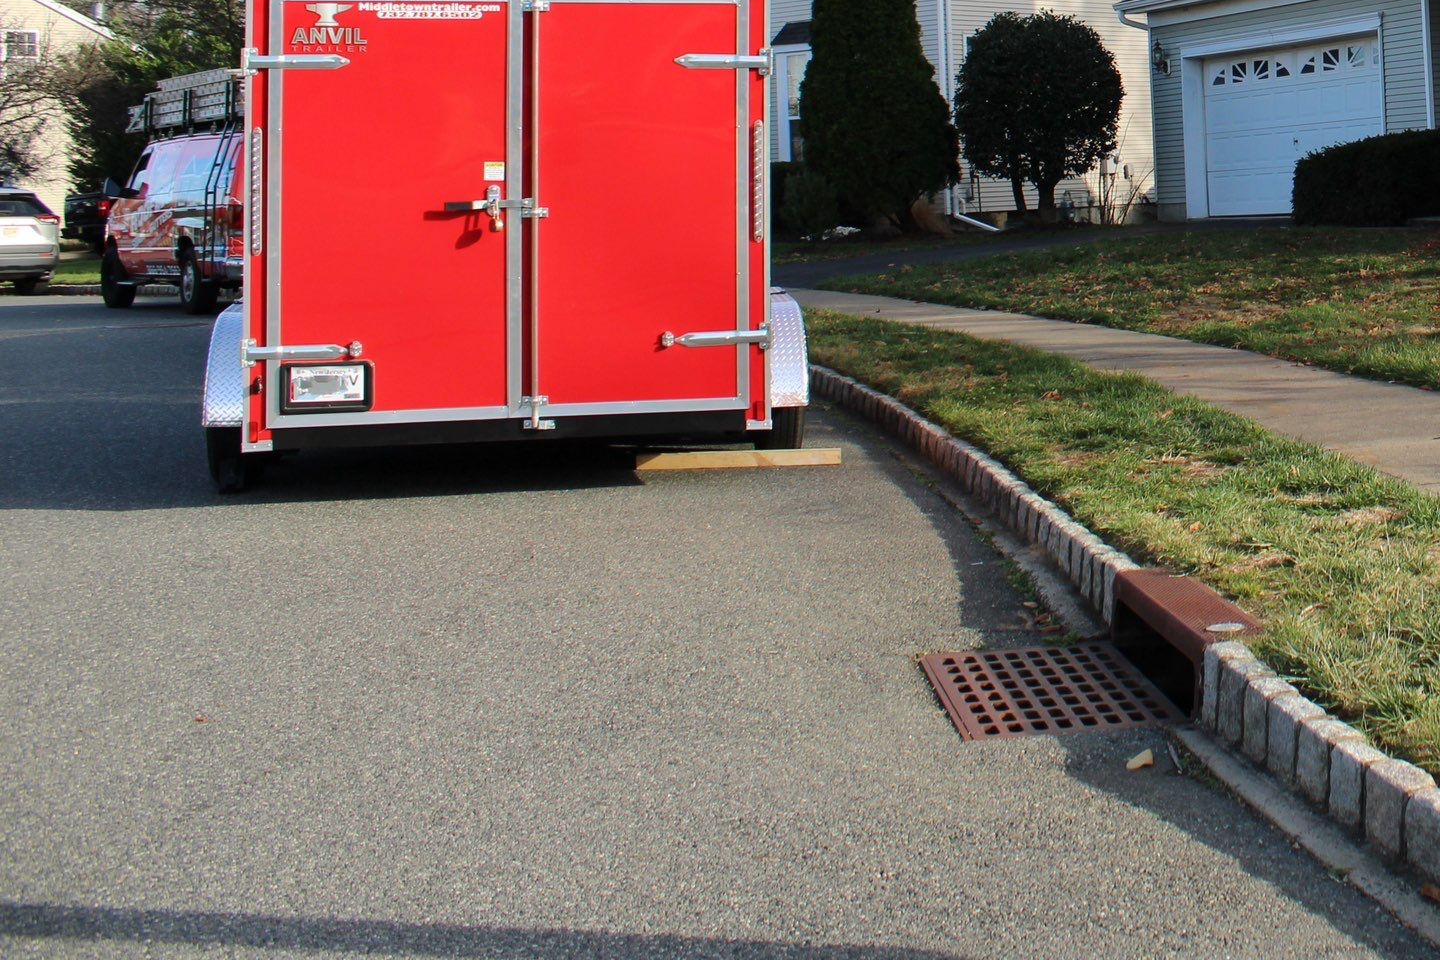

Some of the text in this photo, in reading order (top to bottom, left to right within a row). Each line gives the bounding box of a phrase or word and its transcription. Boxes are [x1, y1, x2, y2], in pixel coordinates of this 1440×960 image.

[358, 2, 500, 13] Middletowntrailer.com
[291, 27, 368, 45] ANVIL
[291, 45, 368, 53] TRAILER
